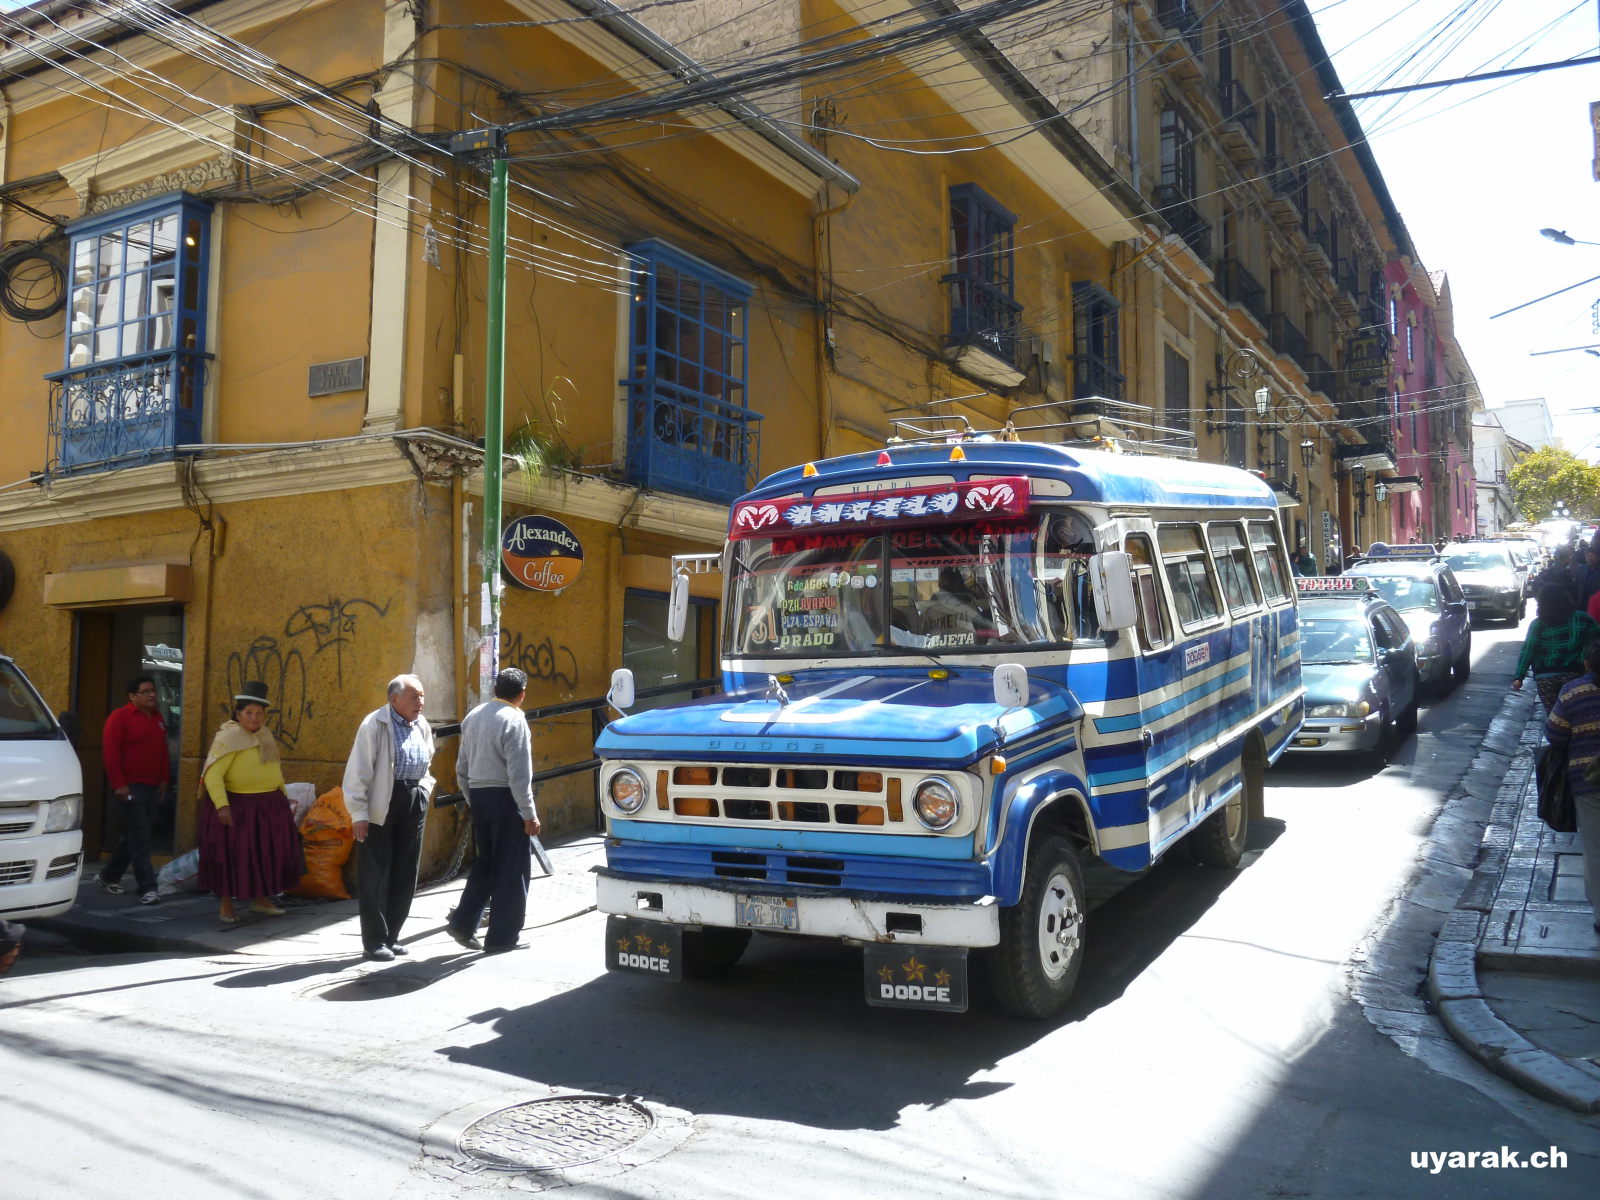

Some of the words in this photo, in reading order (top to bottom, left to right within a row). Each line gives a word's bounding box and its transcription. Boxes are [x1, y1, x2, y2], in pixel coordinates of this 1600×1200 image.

[782, 492, 959, 526] ANGELO
[507, 522, 579, 552] Alexander
[523, 561, 565, 587] Coffee
[1299, 578, 1353, 590] 794444
[780, 632, 834, 648] PRADO
[707, 740, 825, 752] DODGE
[618, 952, 670, 973] DODGE
[880, 983, 951, 1002] DODGE
